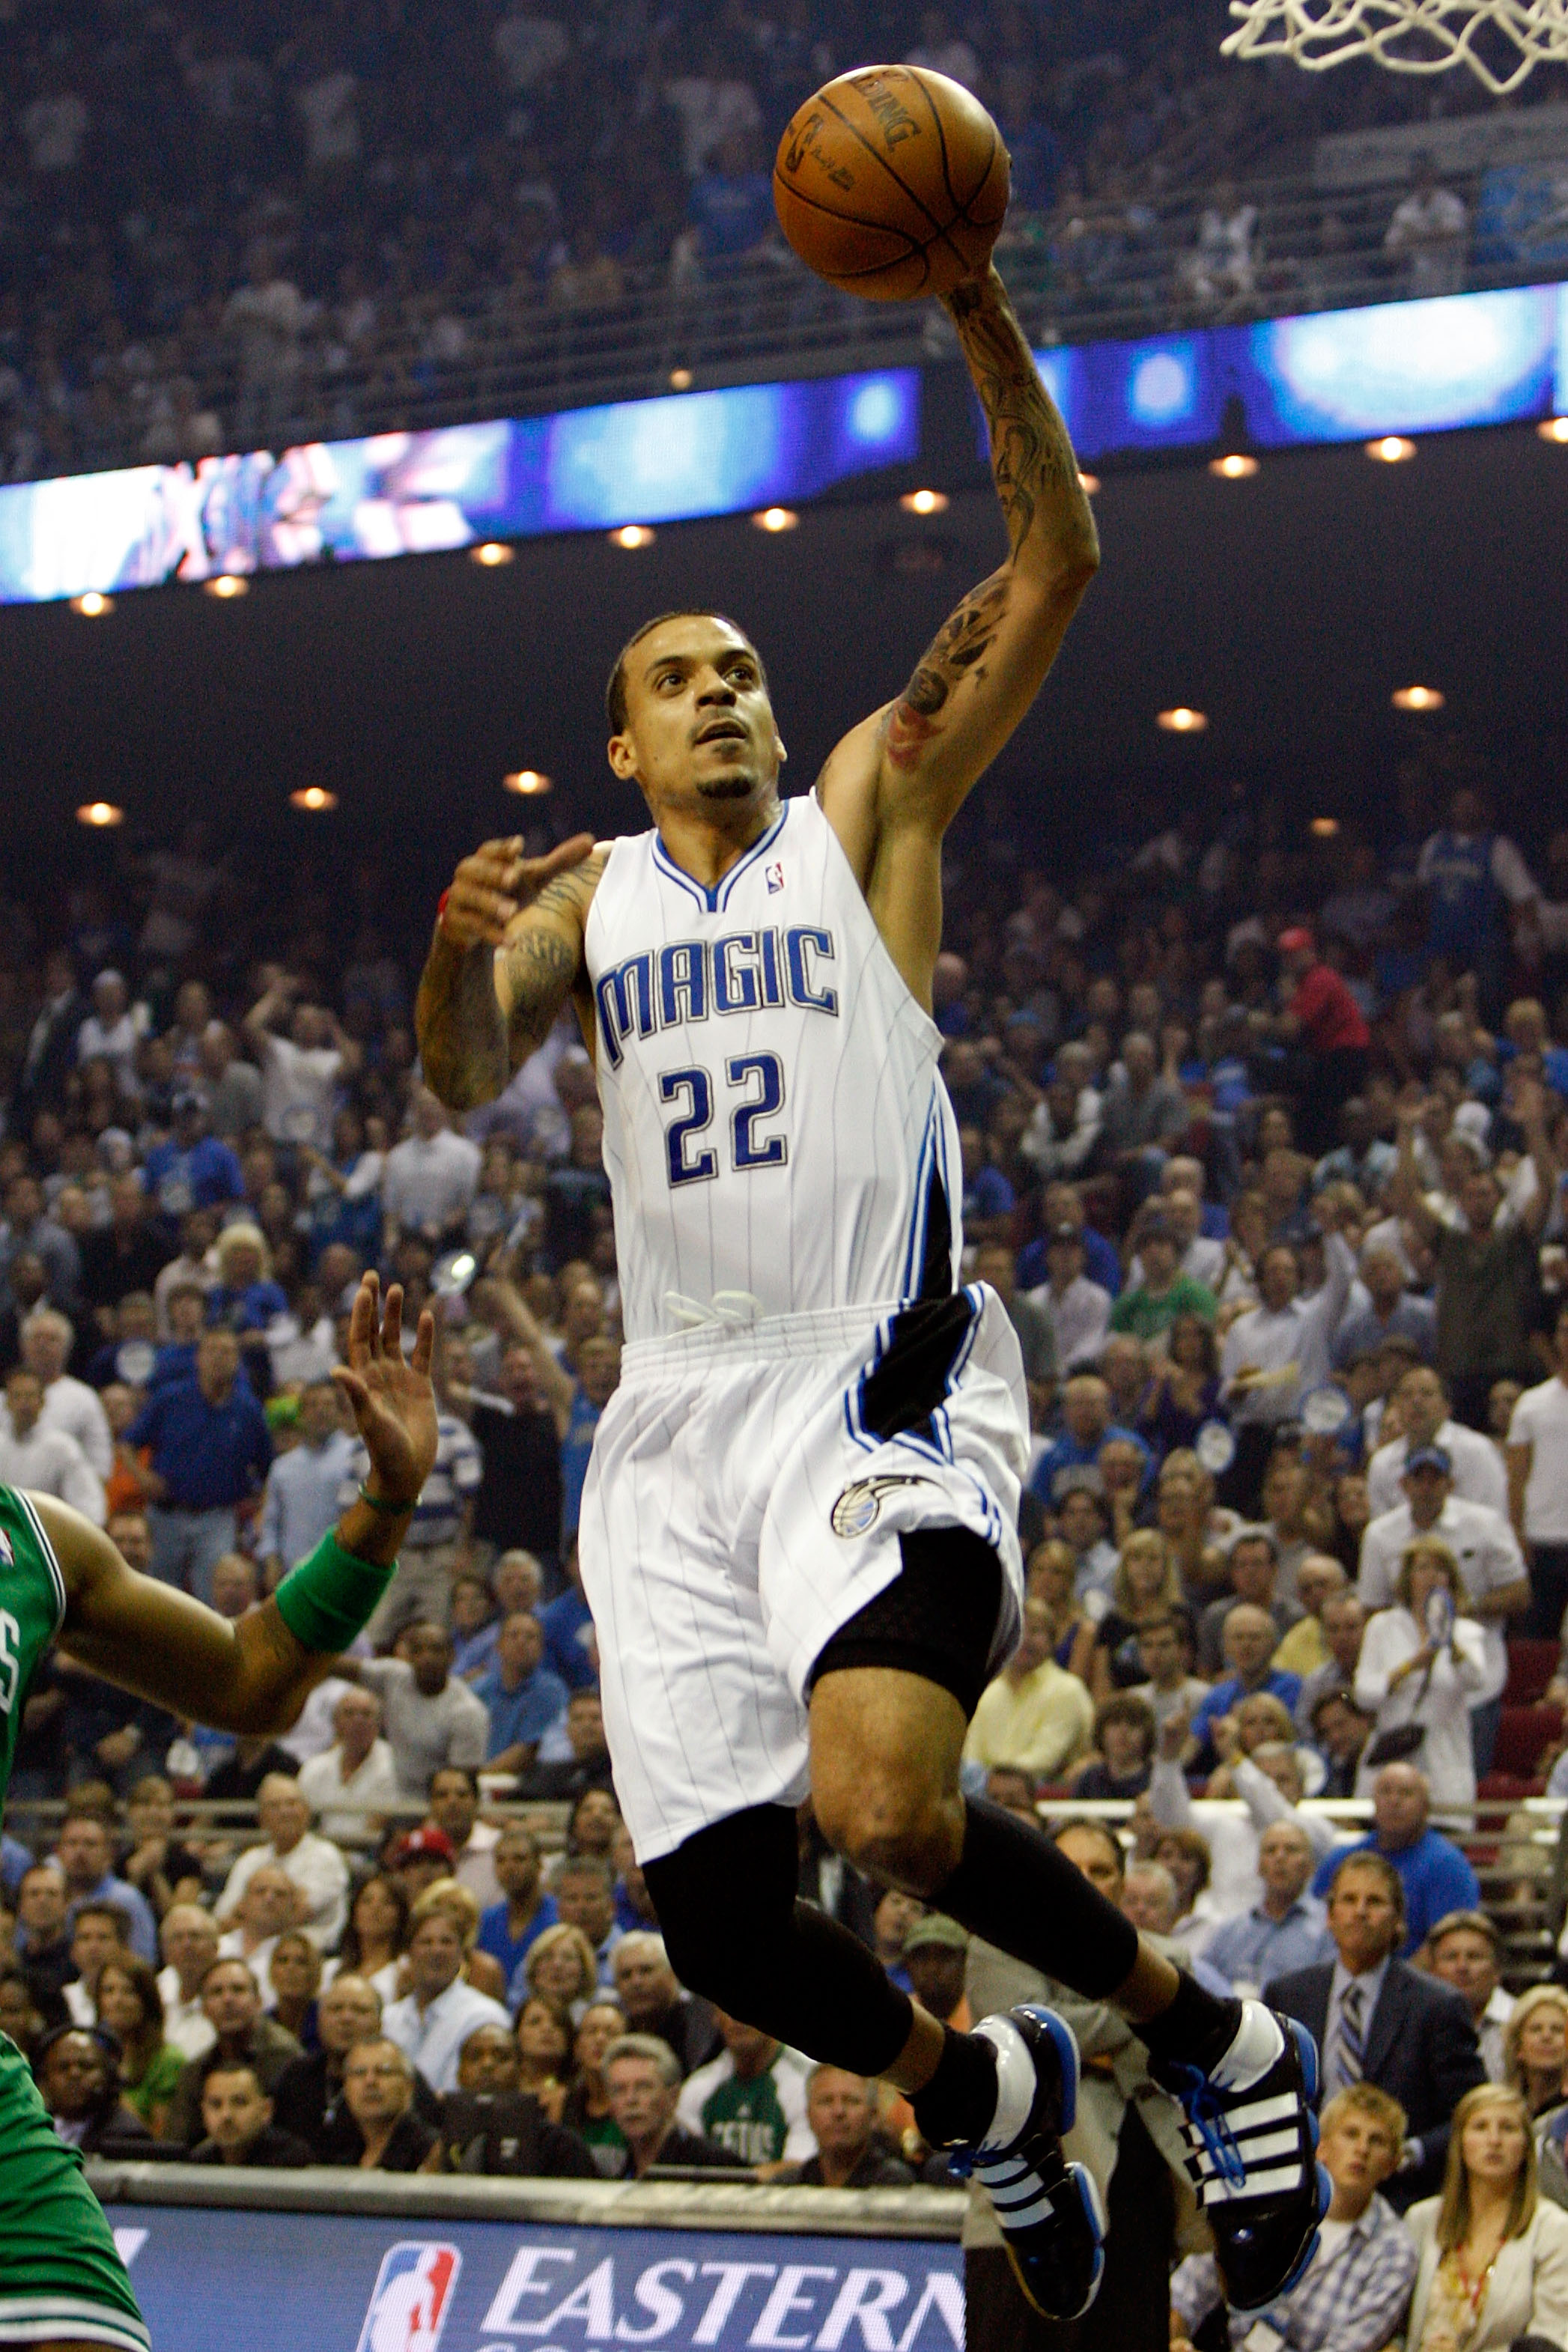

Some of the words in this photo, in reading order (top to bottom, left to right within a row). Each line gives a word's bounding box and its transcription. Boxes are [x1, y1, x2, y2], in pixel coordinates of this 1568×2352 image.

[595, 924, 839, 1071] MAGIC
[657, 1049, 788, 1189] 22
[480, 2246, 967, 2352] EASTERN
